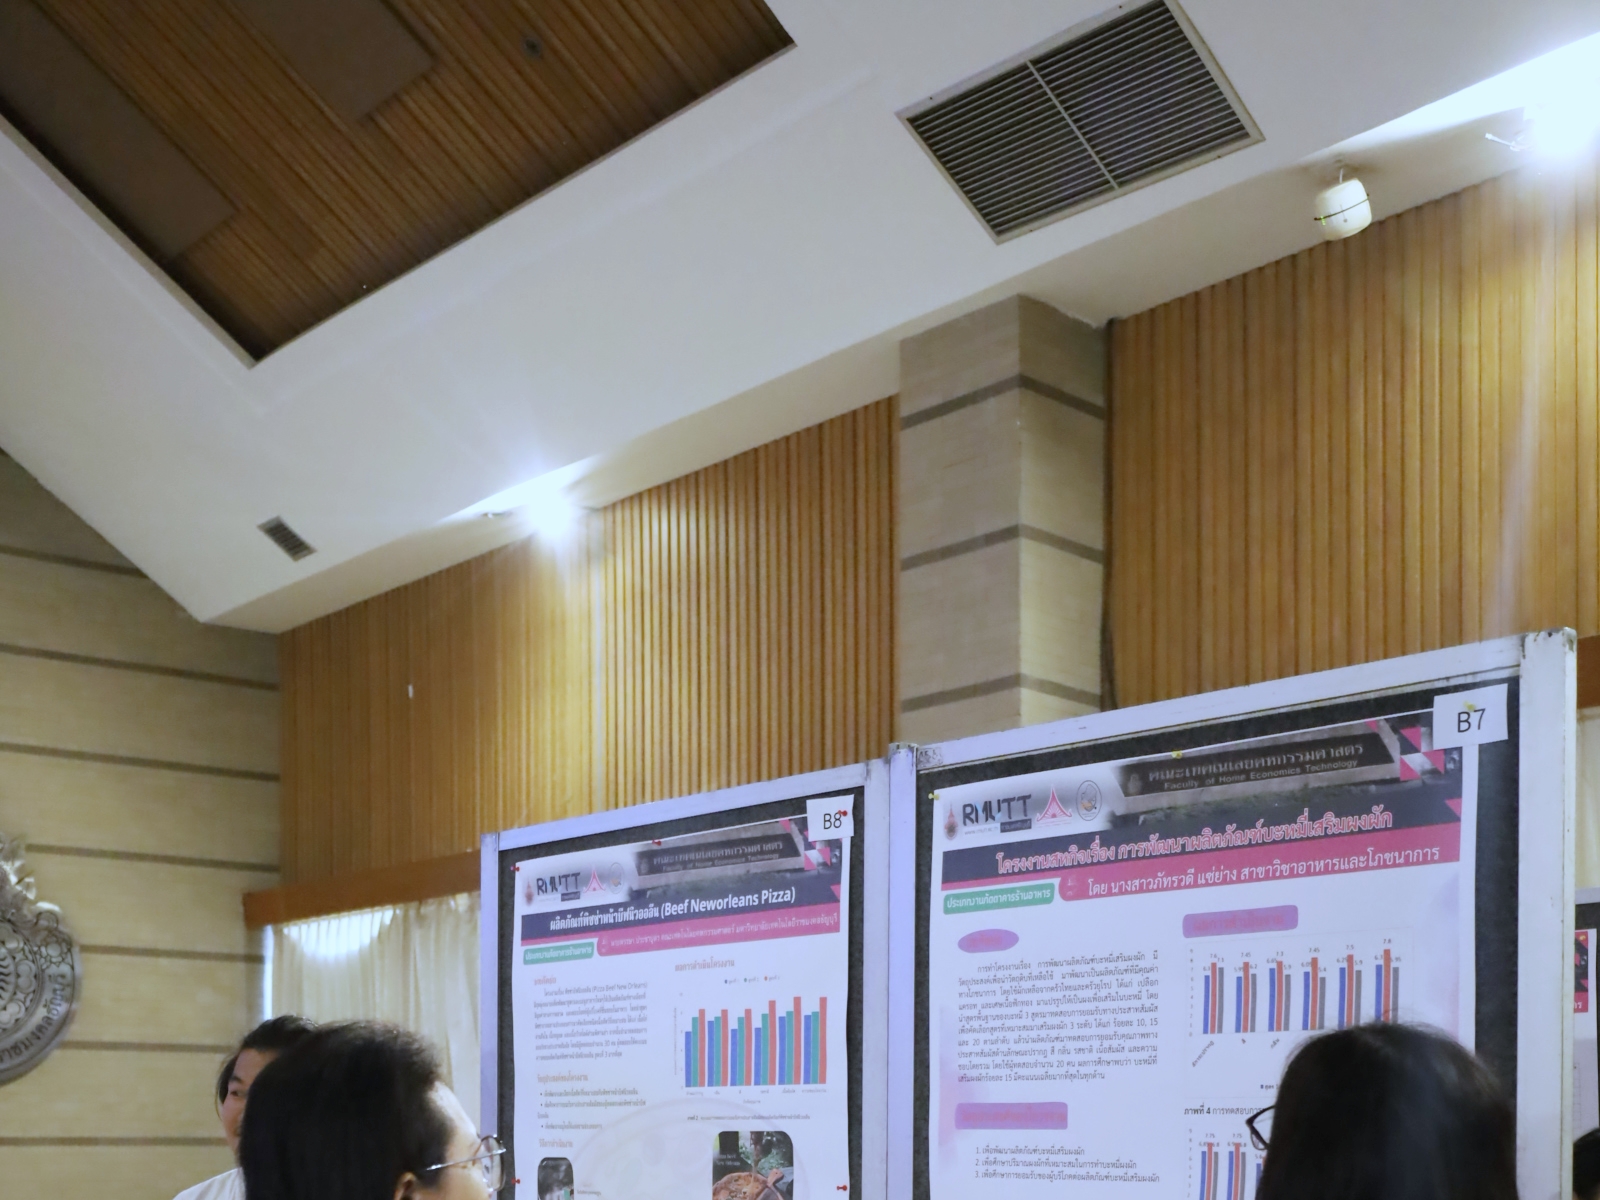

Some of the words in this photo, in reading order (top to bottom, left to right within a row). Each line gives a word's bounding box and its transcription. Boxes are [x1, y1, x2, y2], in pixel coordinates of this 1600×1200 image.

[1456, 709, 1486, 733] B7
[1164, 778, 1198, 792] Faculty
[1206, 776, 1214, 786] of
[1219, 772, 1245, 784] Home
[1250, 765, 1300, 780] Economics
[1306, 758, 1357, 774] Technology
[823, 812, 842, 829] B8
[962, 794, 1031, 826] RMUTT
[996, 837, 1114, 873] โครงงานสหกิจเรื่อง
[1118, 801, 1391, 858] การพัฒนาผลิตภัณฑ์บะหมี่เสริมผงผัก
[1088, 876, 1106, 896] โดย
[1240, 842, 1439, 880] สาขาวิชาอาหารและโภชนาการ
[536, 871, 580, 895] RMUTT
[661, 898, 691, 919] (Beef
[690, 892, 759, 913] Neworleans
[761, 885, 795, 906] Pizza)
[1150, 1017, 1158, 1026] 15
[972, 1038, 980, 1046] 20
[1005, 1073, 1012, 1081] 15
[1184, 1102, 1204, 1114] ภาพที่
[974, 1170, 980, 1178] 3.
